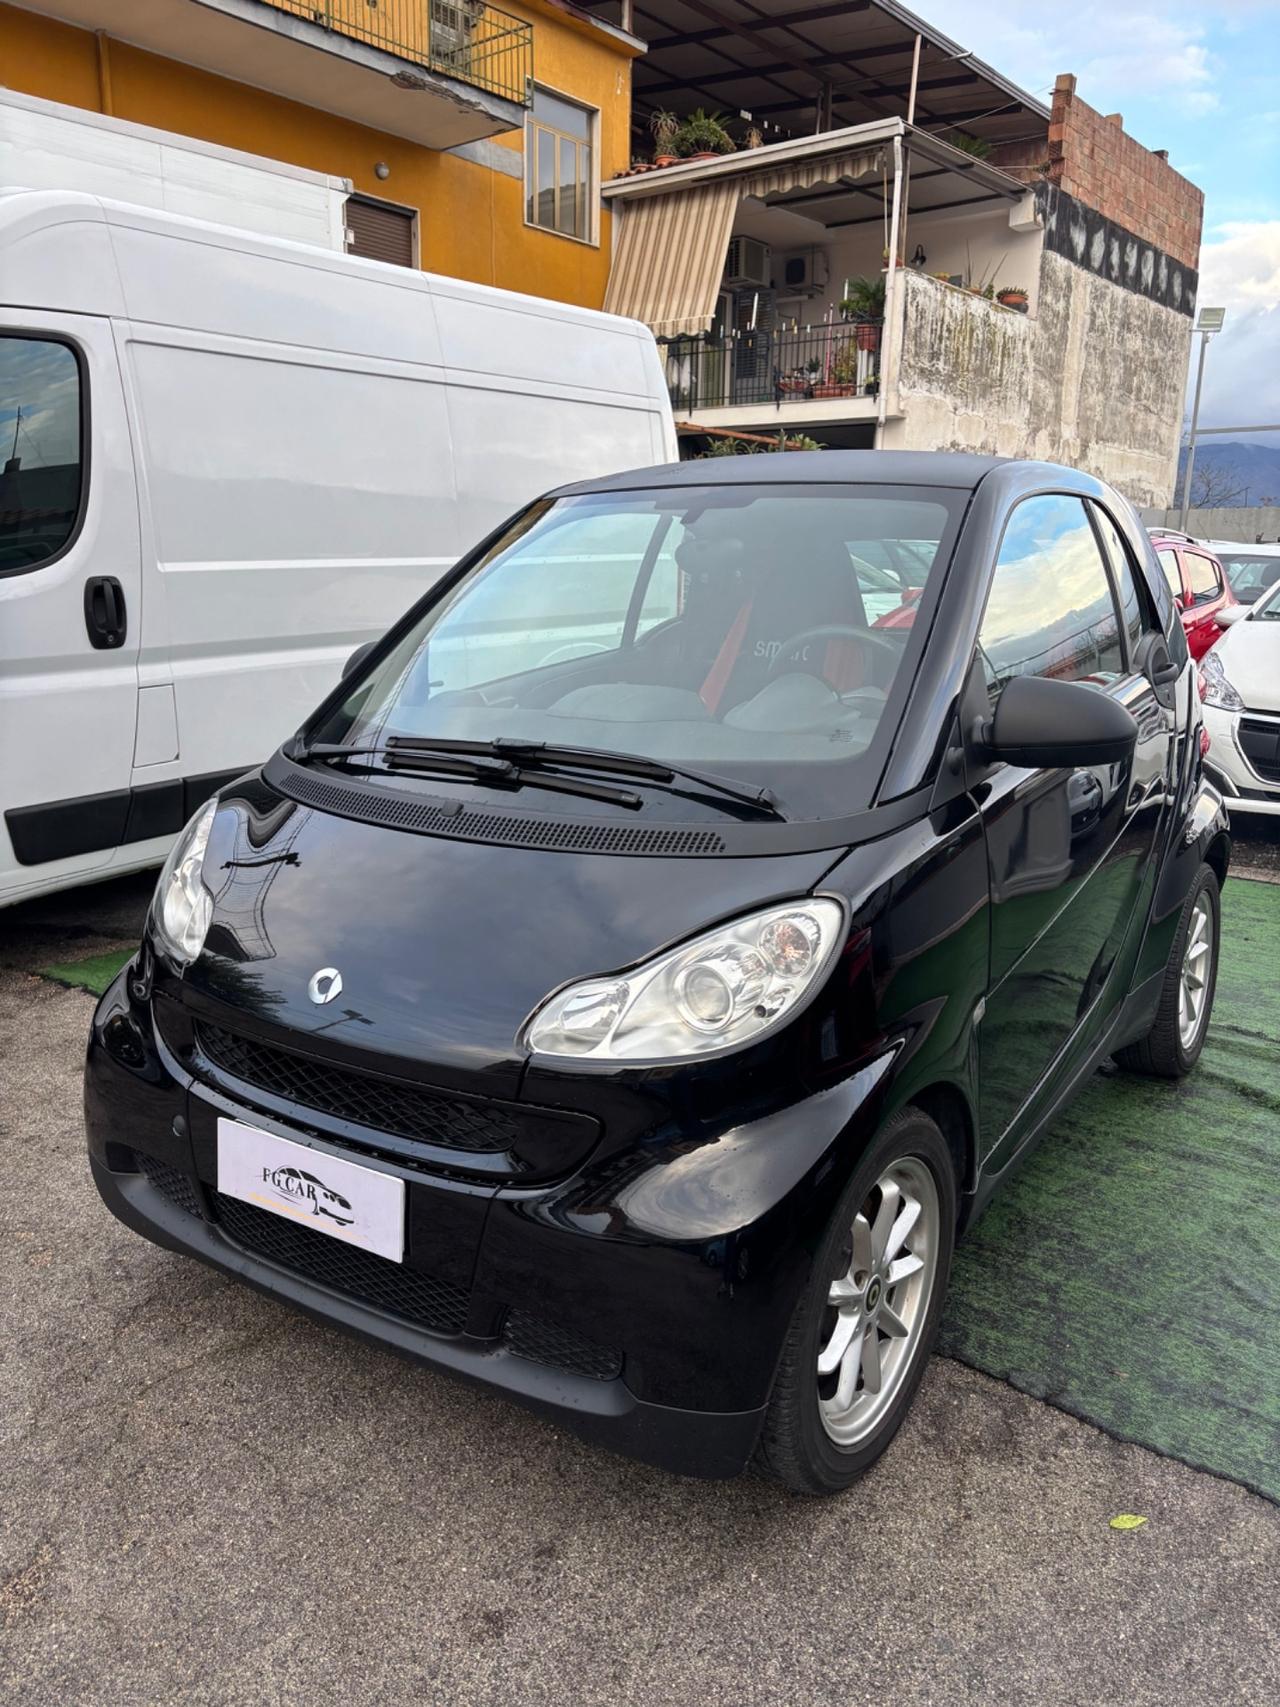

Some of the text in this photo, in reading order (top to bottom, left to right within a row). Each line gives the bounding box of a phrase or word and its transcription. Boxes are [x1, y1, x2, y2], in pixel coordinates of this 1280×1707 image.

[754, 640, 810, 660] smt
[263, 1167, 317, 1203] FG CAR
